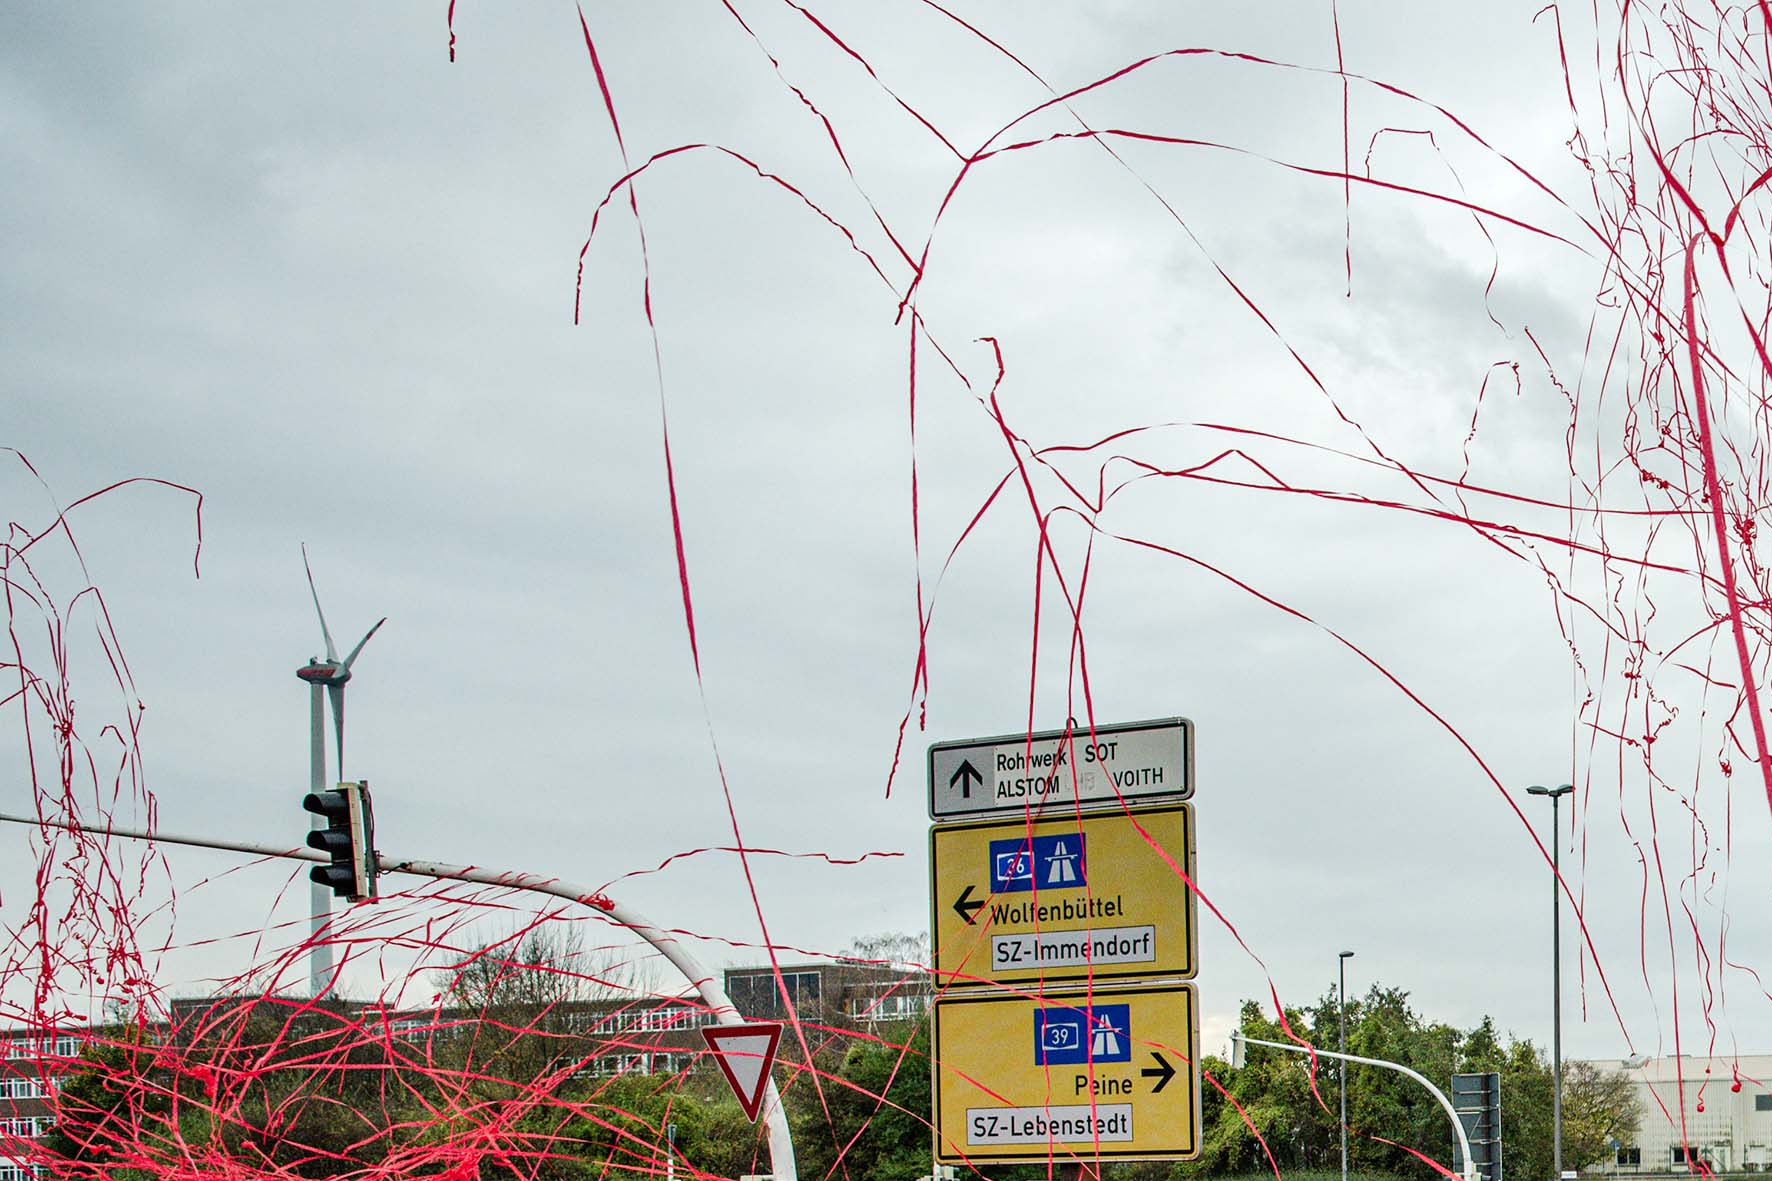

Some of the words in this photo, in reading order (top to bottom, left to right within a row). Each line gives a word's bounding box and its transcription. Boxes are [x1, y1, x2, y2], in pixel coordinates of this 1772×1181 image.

[997, 749, 1067, 771] Rohrwerk
[1085, 743, 1118, 763] SOT
[997, 775, 1060, 799] ALSTOM
[1113, 767, 1163, 788] VOITH
[991, 895, 1123, 925] Wolfenbüttel
[997, 933, 1150, 963] SZ-Immendorf
[1051, 1029, 1068, 1045] 39
[1075, 1075, 1133, 1096] Peine
[973, 1112, 1128, 1138] SZ-Lebenstedt
